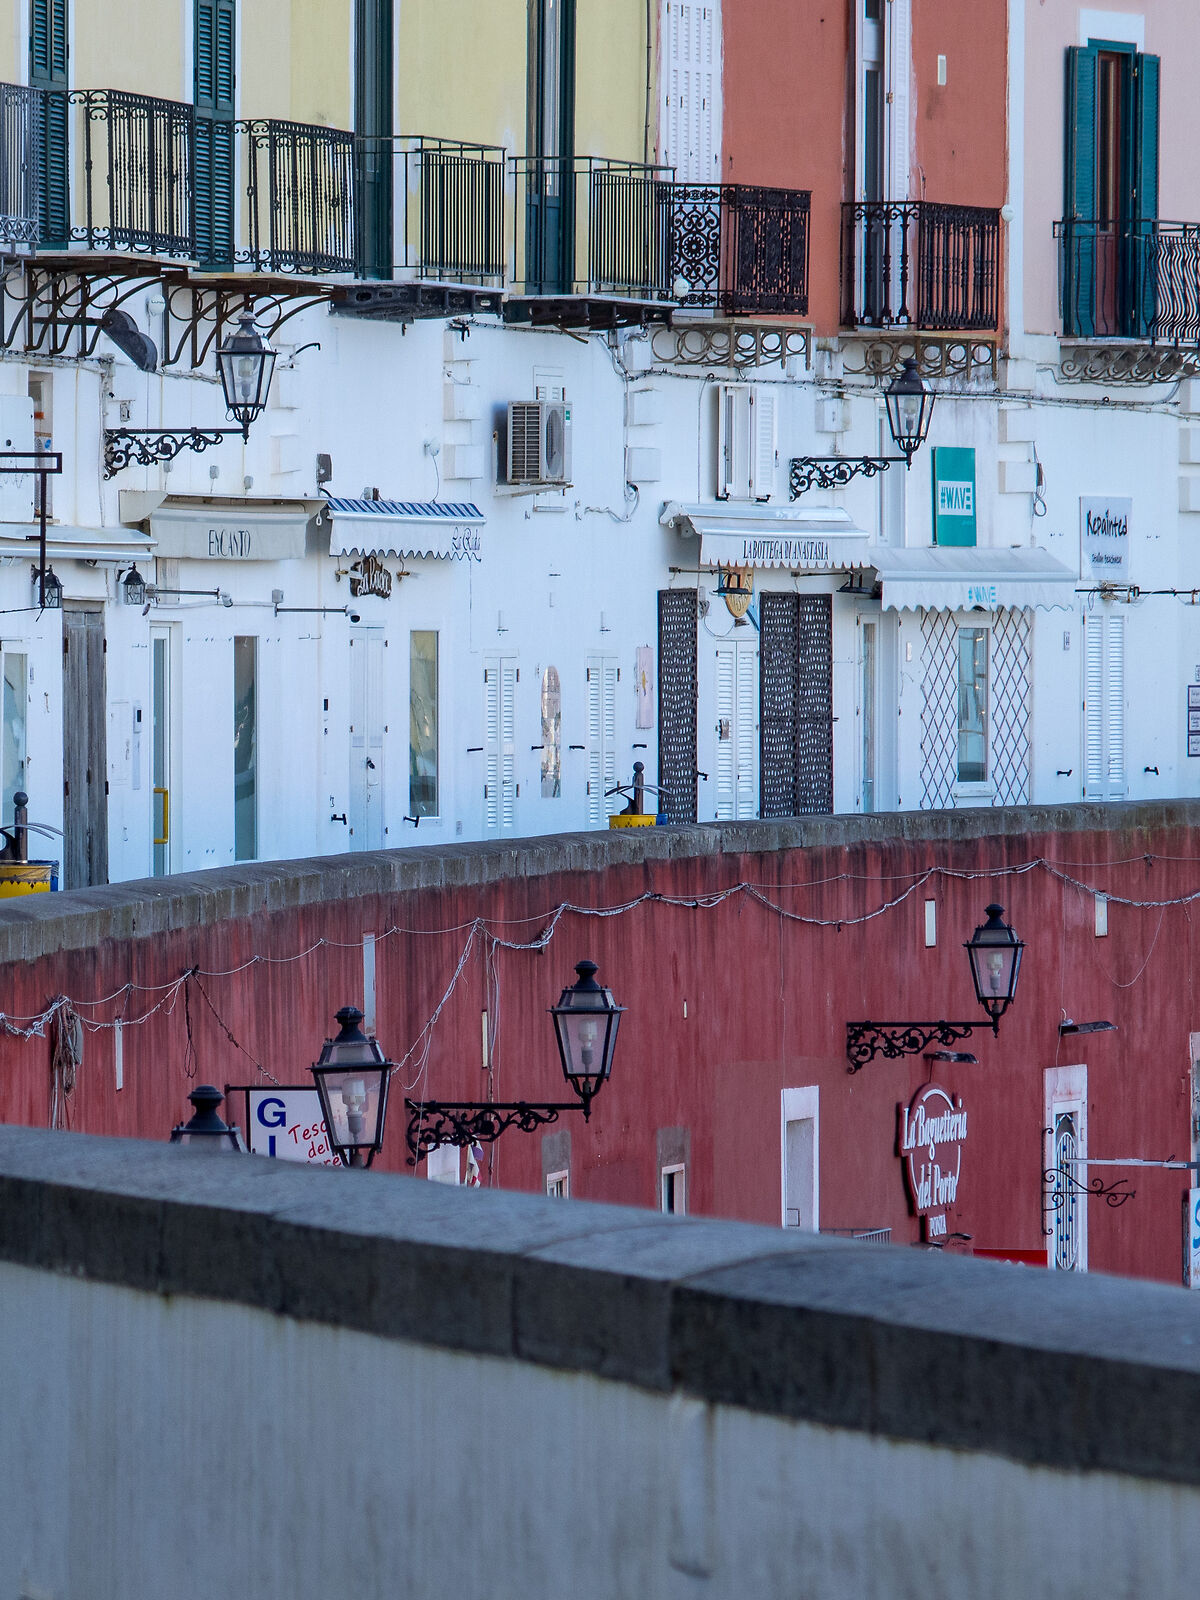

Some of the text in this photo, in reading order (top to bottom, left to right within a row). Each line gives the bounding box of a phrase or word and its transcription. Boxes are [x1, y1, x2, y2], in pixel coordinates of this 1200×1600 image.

[940, 486, 971, 510] #WAVE
[1086, 508, 1128, 538] Repainted
[209, 529, 251, 557] ENCANTO
[743, 540, 829, 560] LA BOTTEGA DI ANASTASIA
[288, 1112, 340, 1144] Teso
[916, 1098, 968, 1161] Baguetteria
[308, 1135, 330, 1158] del
[918, 1162, 958, 1210] del Porto
